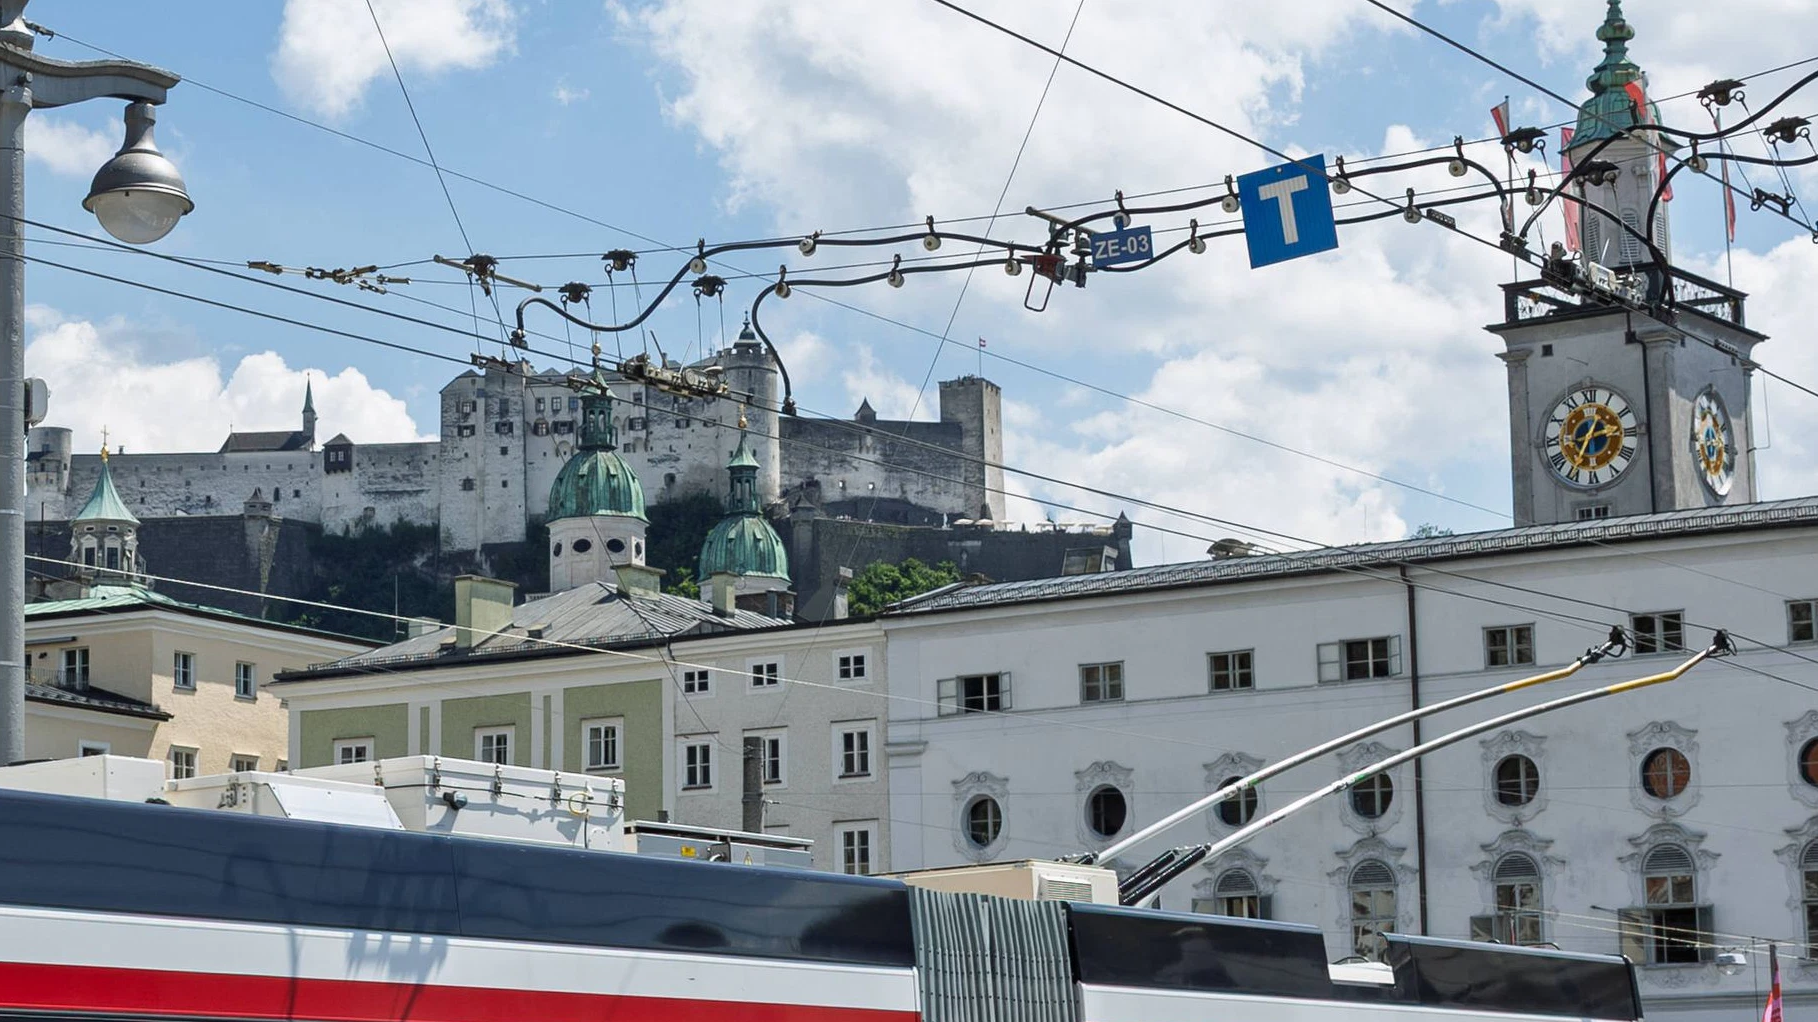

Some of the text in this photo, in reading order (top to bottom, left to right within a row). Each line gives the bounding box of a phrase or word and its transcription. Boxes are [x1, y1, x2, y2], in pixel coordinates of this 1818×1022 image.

[1258, 175, 1309, 245] T
[1095, 235, 1150, 259] ZE-03
[1562, 396, 1579, 409] XI
[1581, 390, 1597, 403] XII
[1605, 393, 1614, 406] I
[1618, 405, 1631, 418] II
[1551, 414, 1564, 426] X
[1624, 427, 1637, 437] III
[1588, 471, 1600, 484] VI
[1609, 464, 1621, 478] V
